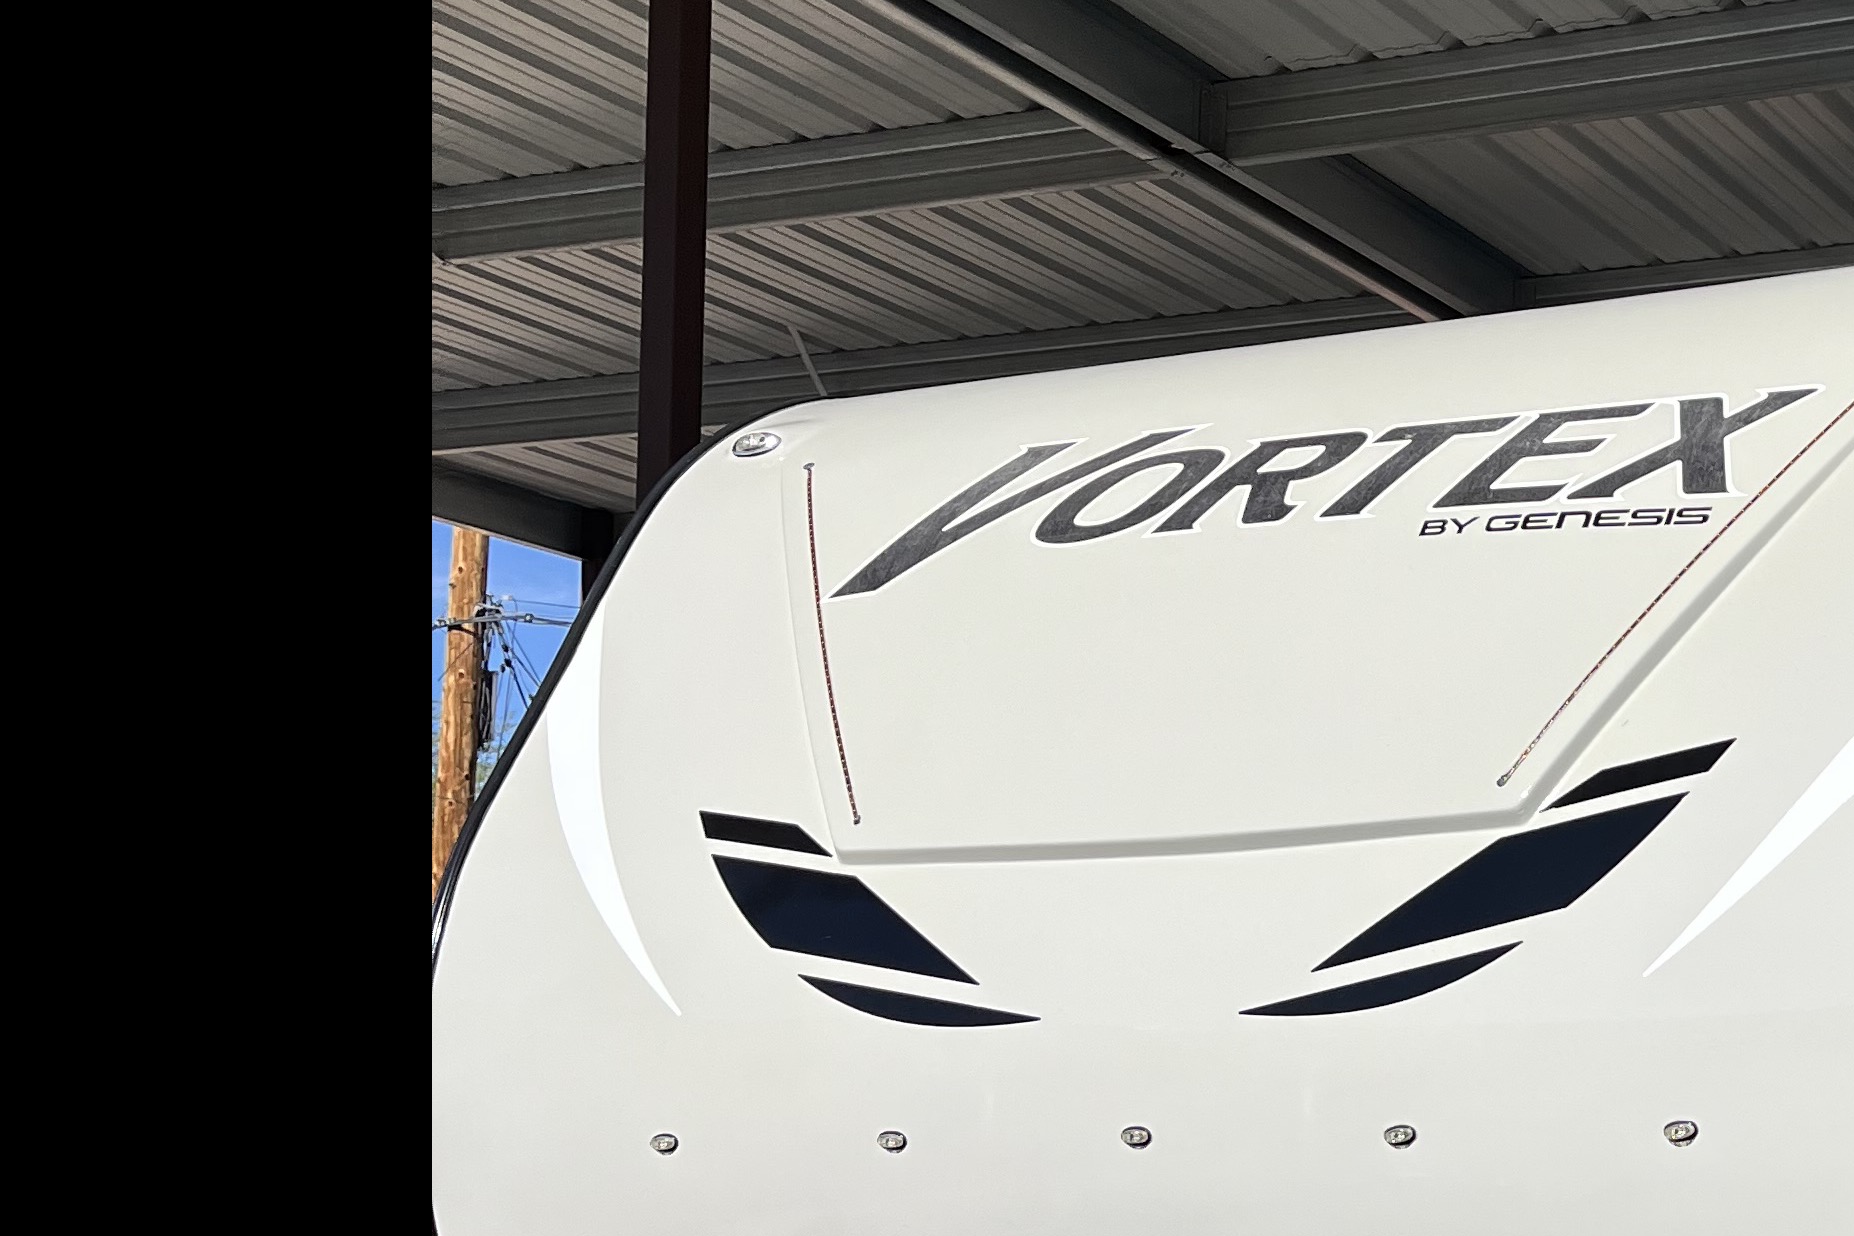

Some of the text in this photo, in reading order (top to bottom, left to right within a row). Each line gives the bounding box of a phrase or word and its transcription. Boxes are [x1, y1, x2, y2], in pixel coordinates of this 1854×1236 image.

[828, 387, 1820, 599] VORTEX
[1419, 507, 1713, 536] BY GENESIS
